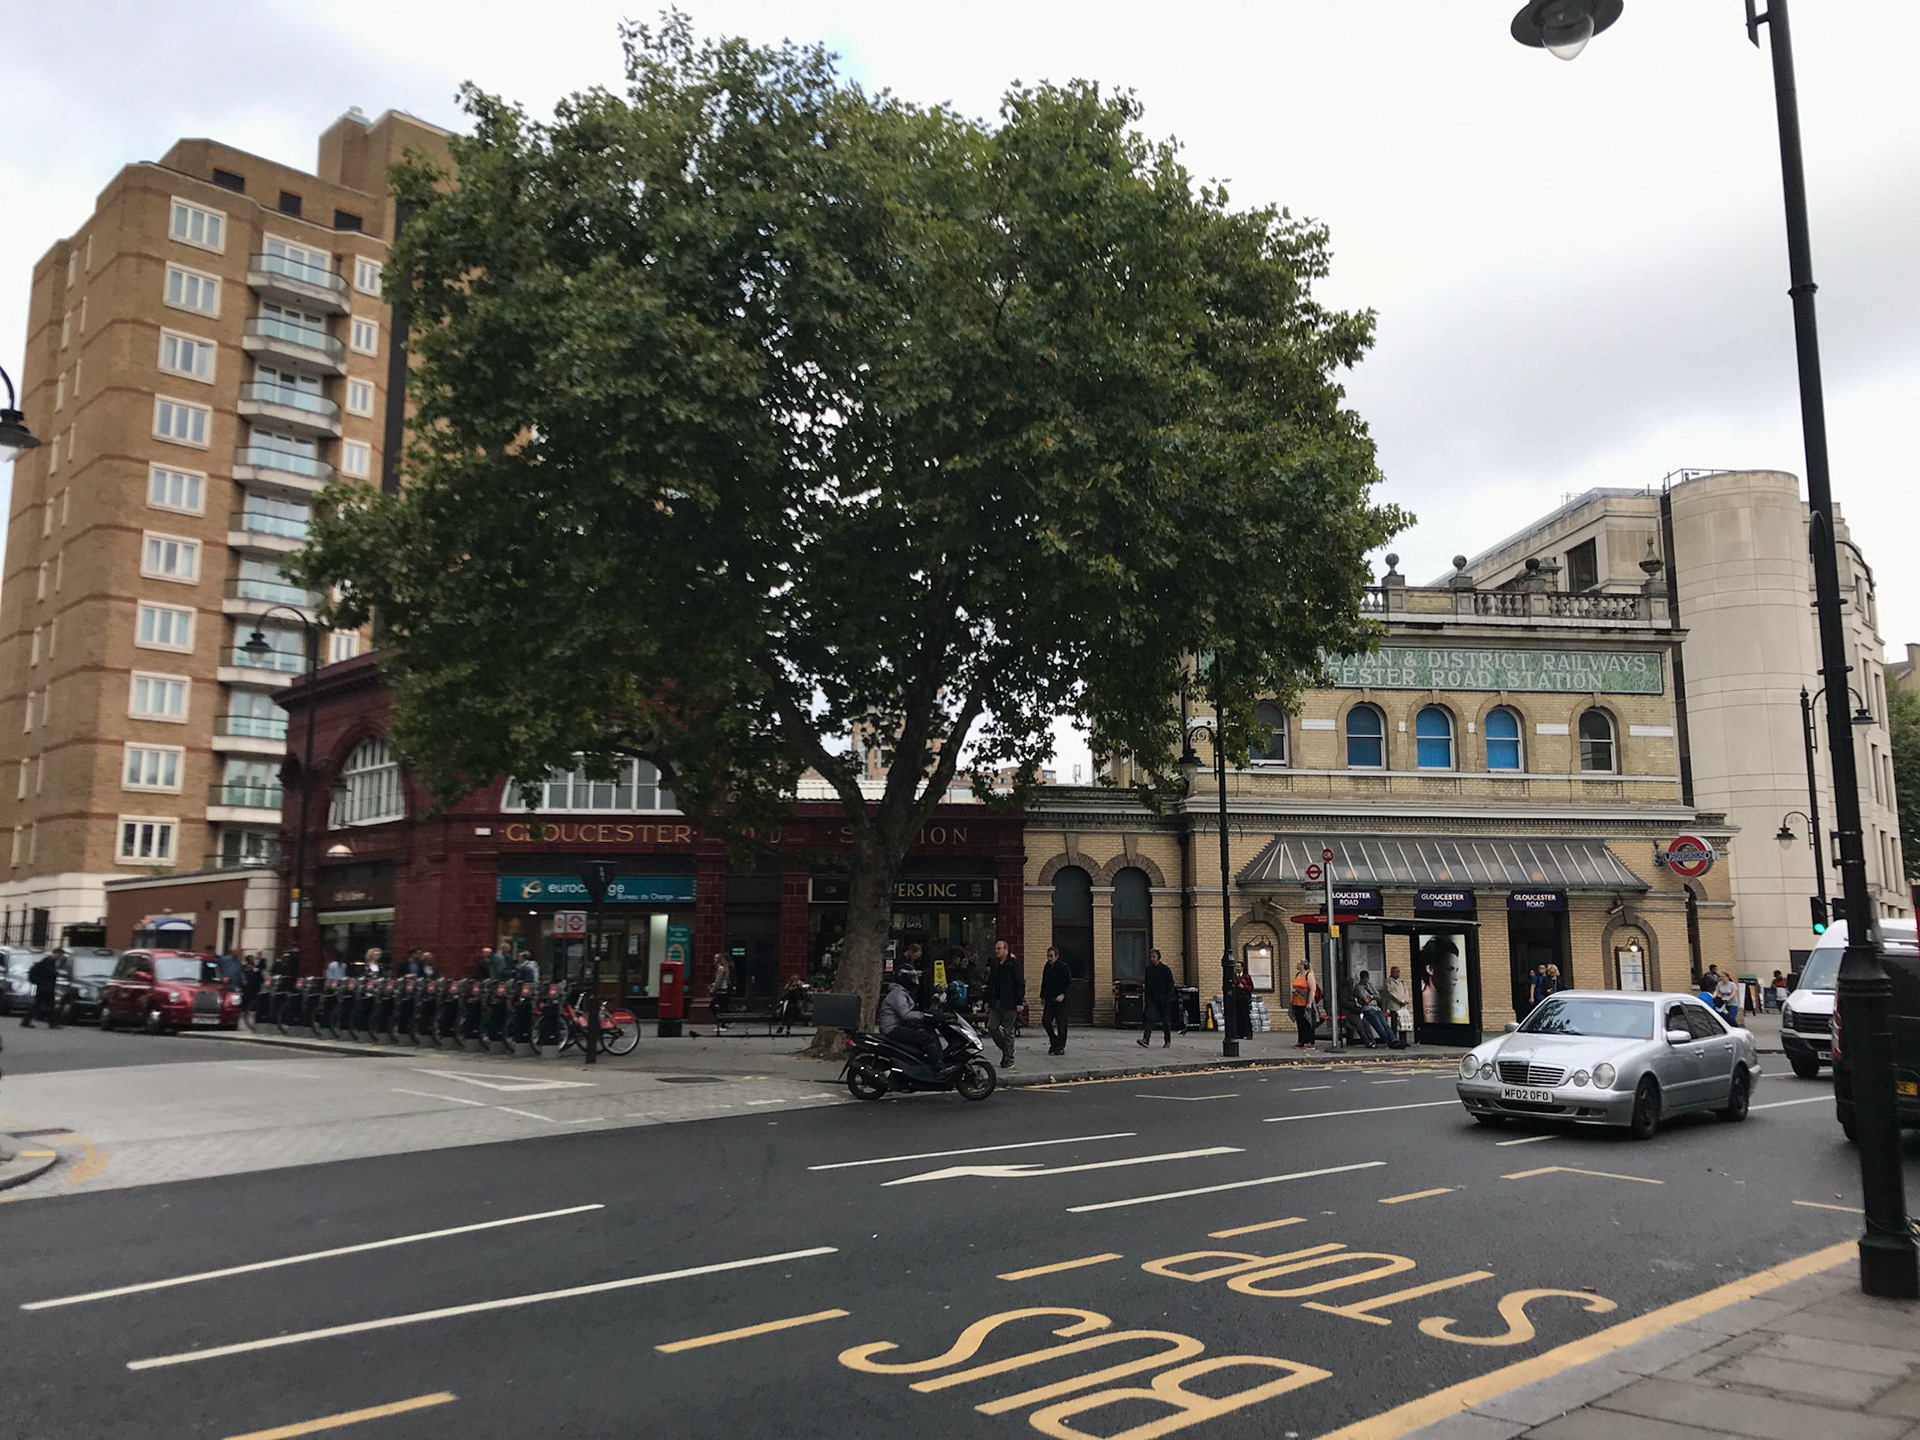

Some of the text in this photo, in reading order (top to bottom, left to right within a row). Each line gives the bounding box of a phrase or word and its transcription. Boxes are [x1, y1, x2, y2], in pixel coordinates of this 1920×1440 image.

[1404, 651, 1417, 666] &
[1428, 652, 1530, 670] DISTRICT
[1542, 654, 1647, 672] RAILWAYS
[1432, 670, 1491, 687] ROAD
[1507, 671, 1602, 689] STATION
[506, 823, 692, 843] GLOUCESTER
[547, 883, 625, 897] eurocge
[928, 883, 957, 898] INC
[1421, 893, 1465, 901] GLOUCESTER
[1513, 893, 1557, 901] GLOUCESTER
[1433, 900, 1453, 908] ROAD
[1526, 900, 1546, 908] ROAD
[1141, 1243, 1619, 1346] STOP
[838, 1306, 1333, 1440] BUS
